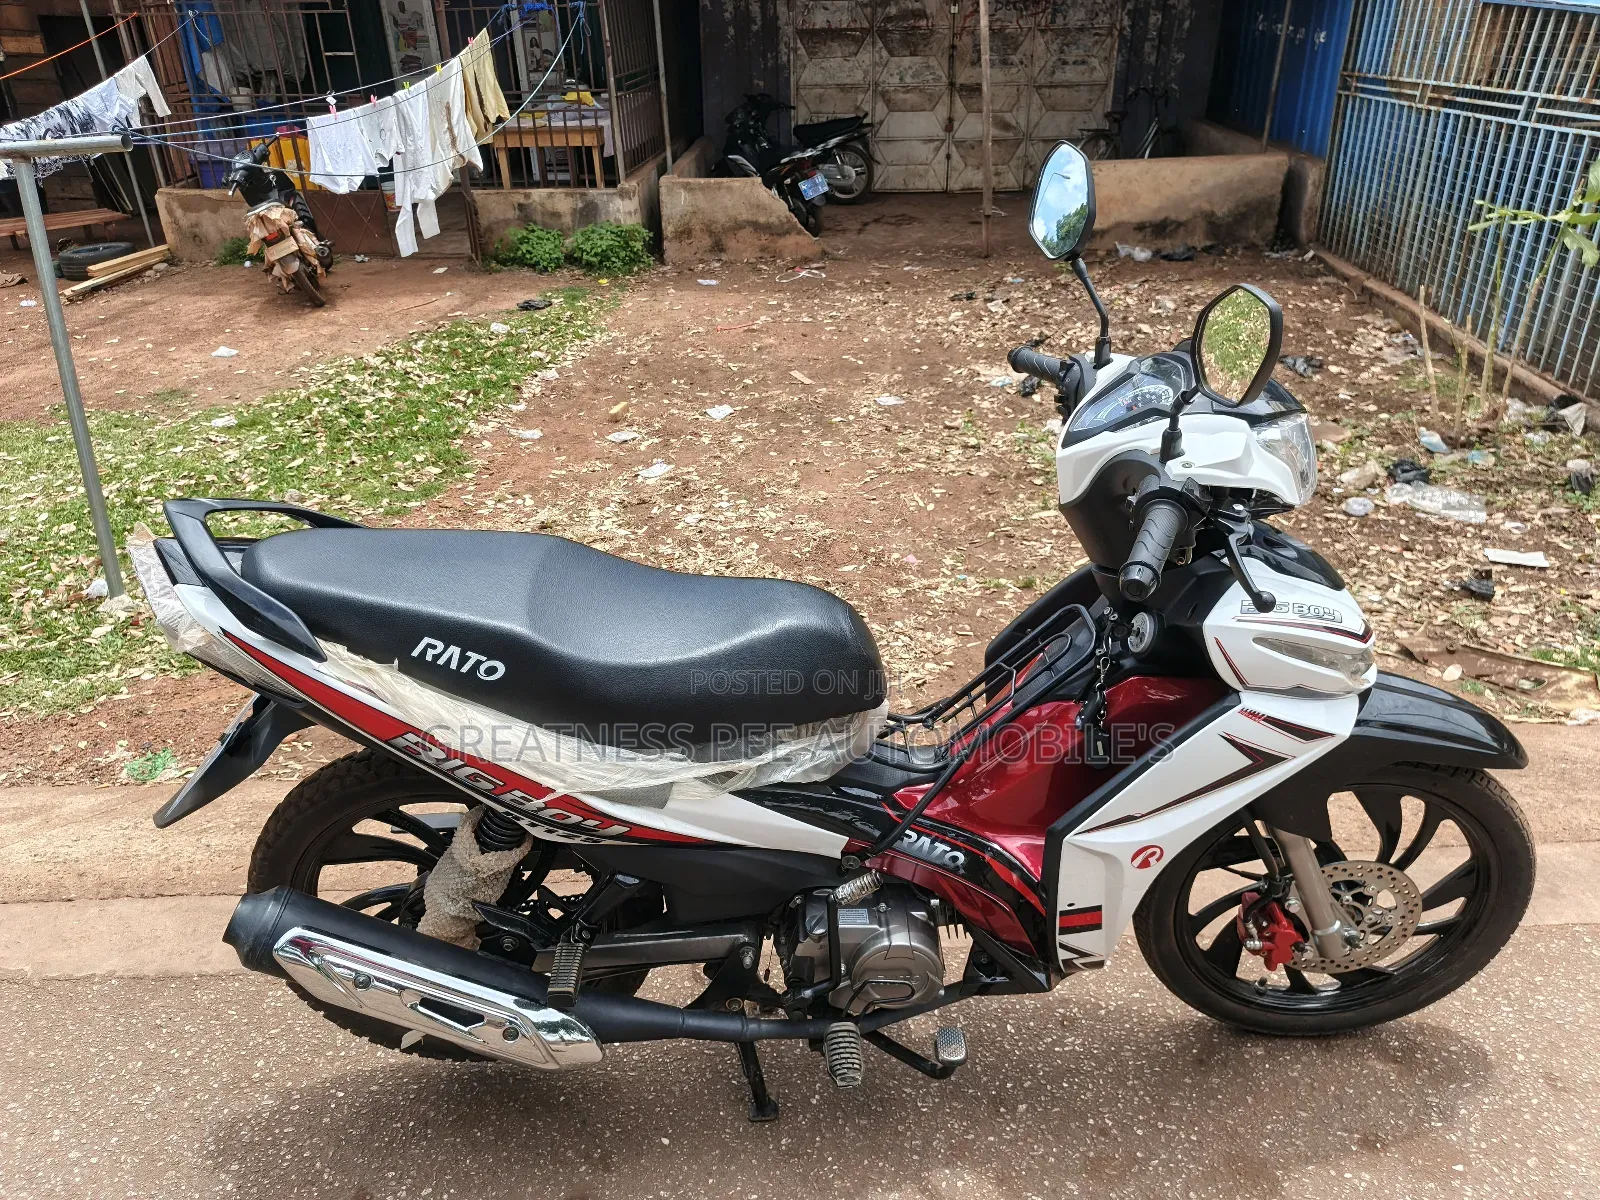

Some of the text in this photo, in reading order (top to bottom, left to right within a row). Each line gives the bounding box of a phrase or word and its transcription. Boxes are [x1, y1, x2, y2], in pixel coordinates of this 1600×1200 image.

[1240, 600, 1343, 623] BG BOY
[410, 636, 506, 681] RATO
[387, 731, 631, 836] BIG BOY
[896, 829, 966, 870] RATO
